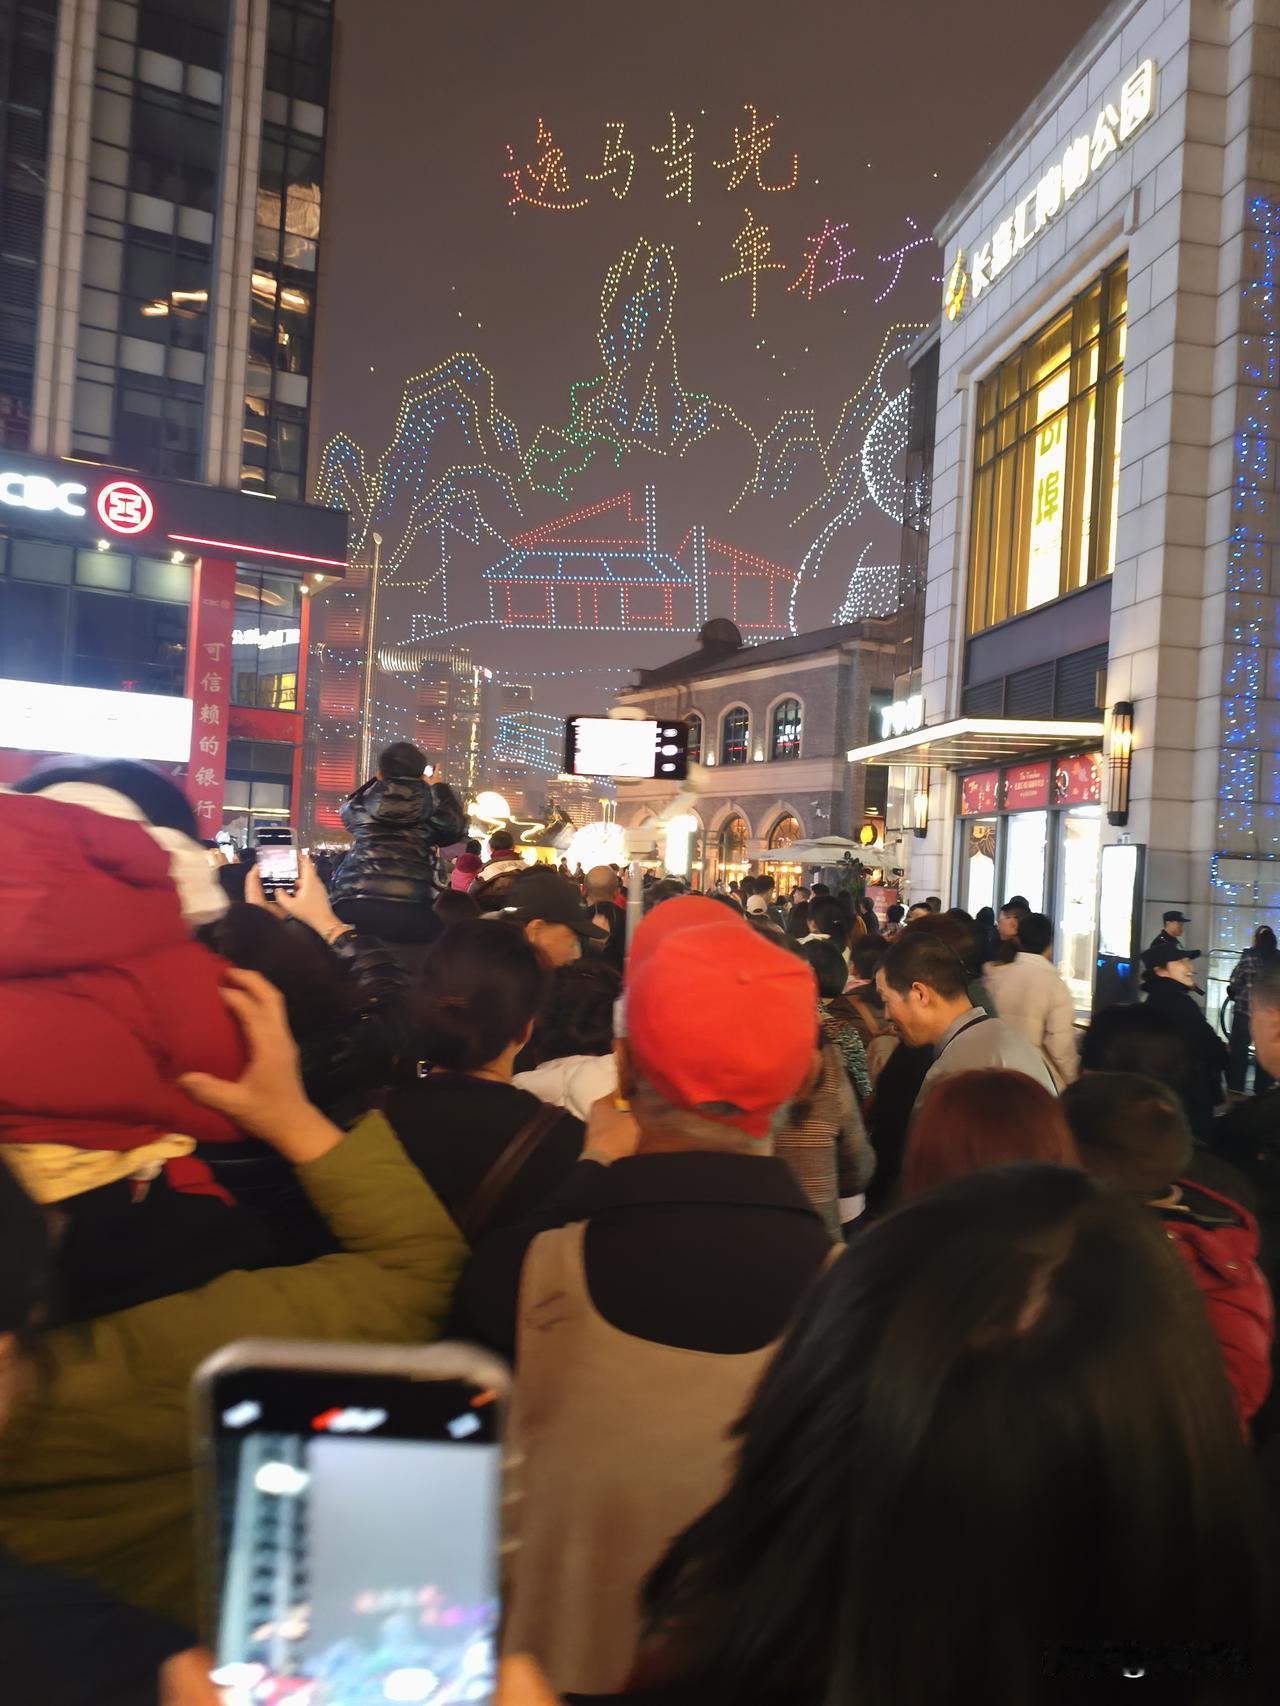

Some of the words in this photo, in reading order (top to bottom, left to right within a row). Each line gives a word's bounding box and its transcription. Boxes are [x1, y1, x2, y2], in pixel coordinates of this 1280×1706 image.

[193, 641, 226, 820] 可信赖的银行
